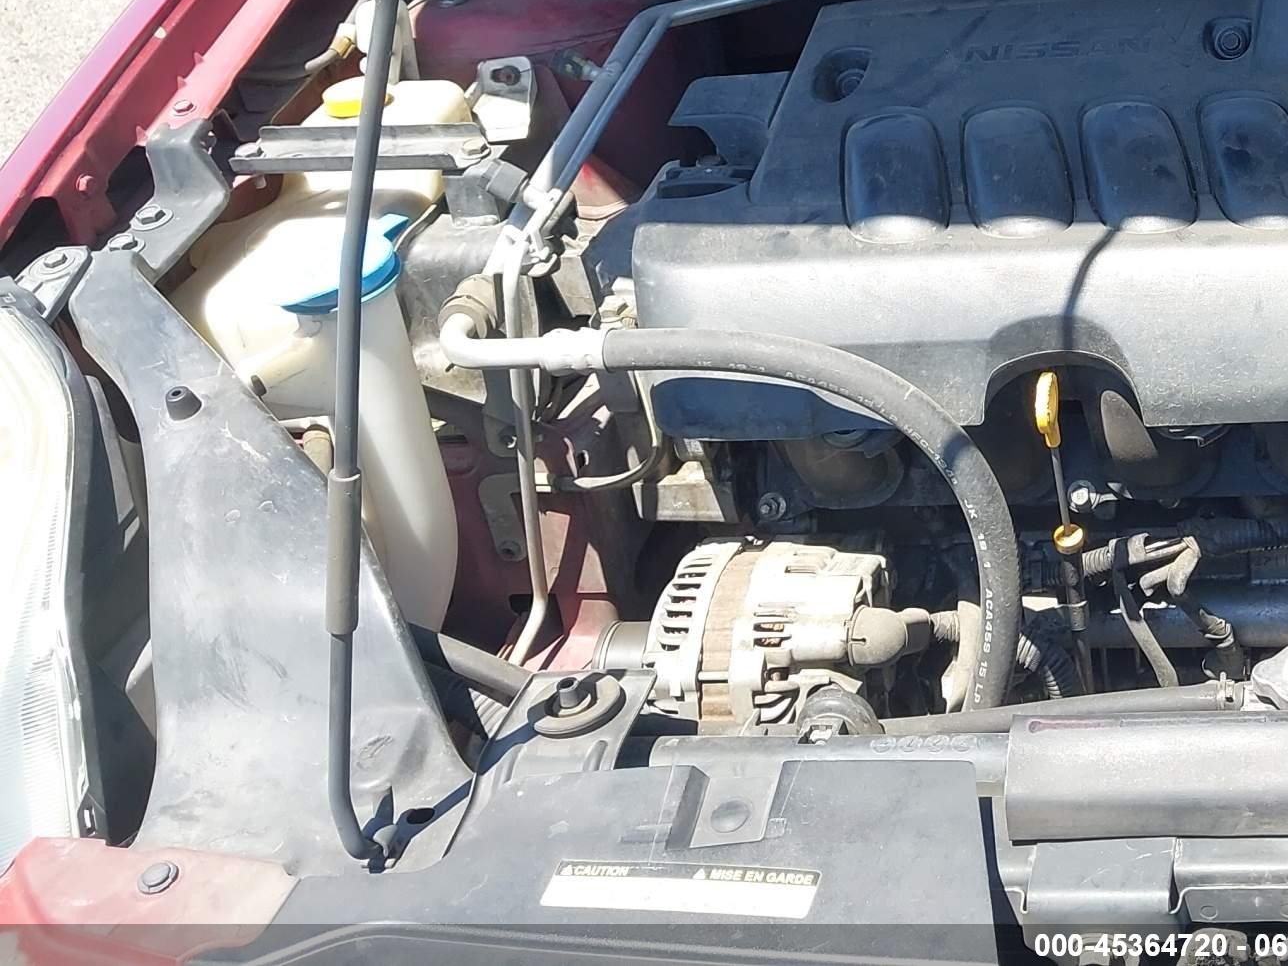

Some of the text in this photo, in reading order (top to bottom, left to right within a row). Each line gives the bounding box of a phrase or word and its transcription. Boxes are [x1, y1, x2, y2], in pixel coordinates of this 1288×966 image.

[964, 35, 1151, 63] NISSAN
[978, 660, 988, 678] 15
[974, 683, 984, 704] LP
[574, 865, 630, 877] CAUTION
[709, 868, 814, 886] MISE EN GARDE
